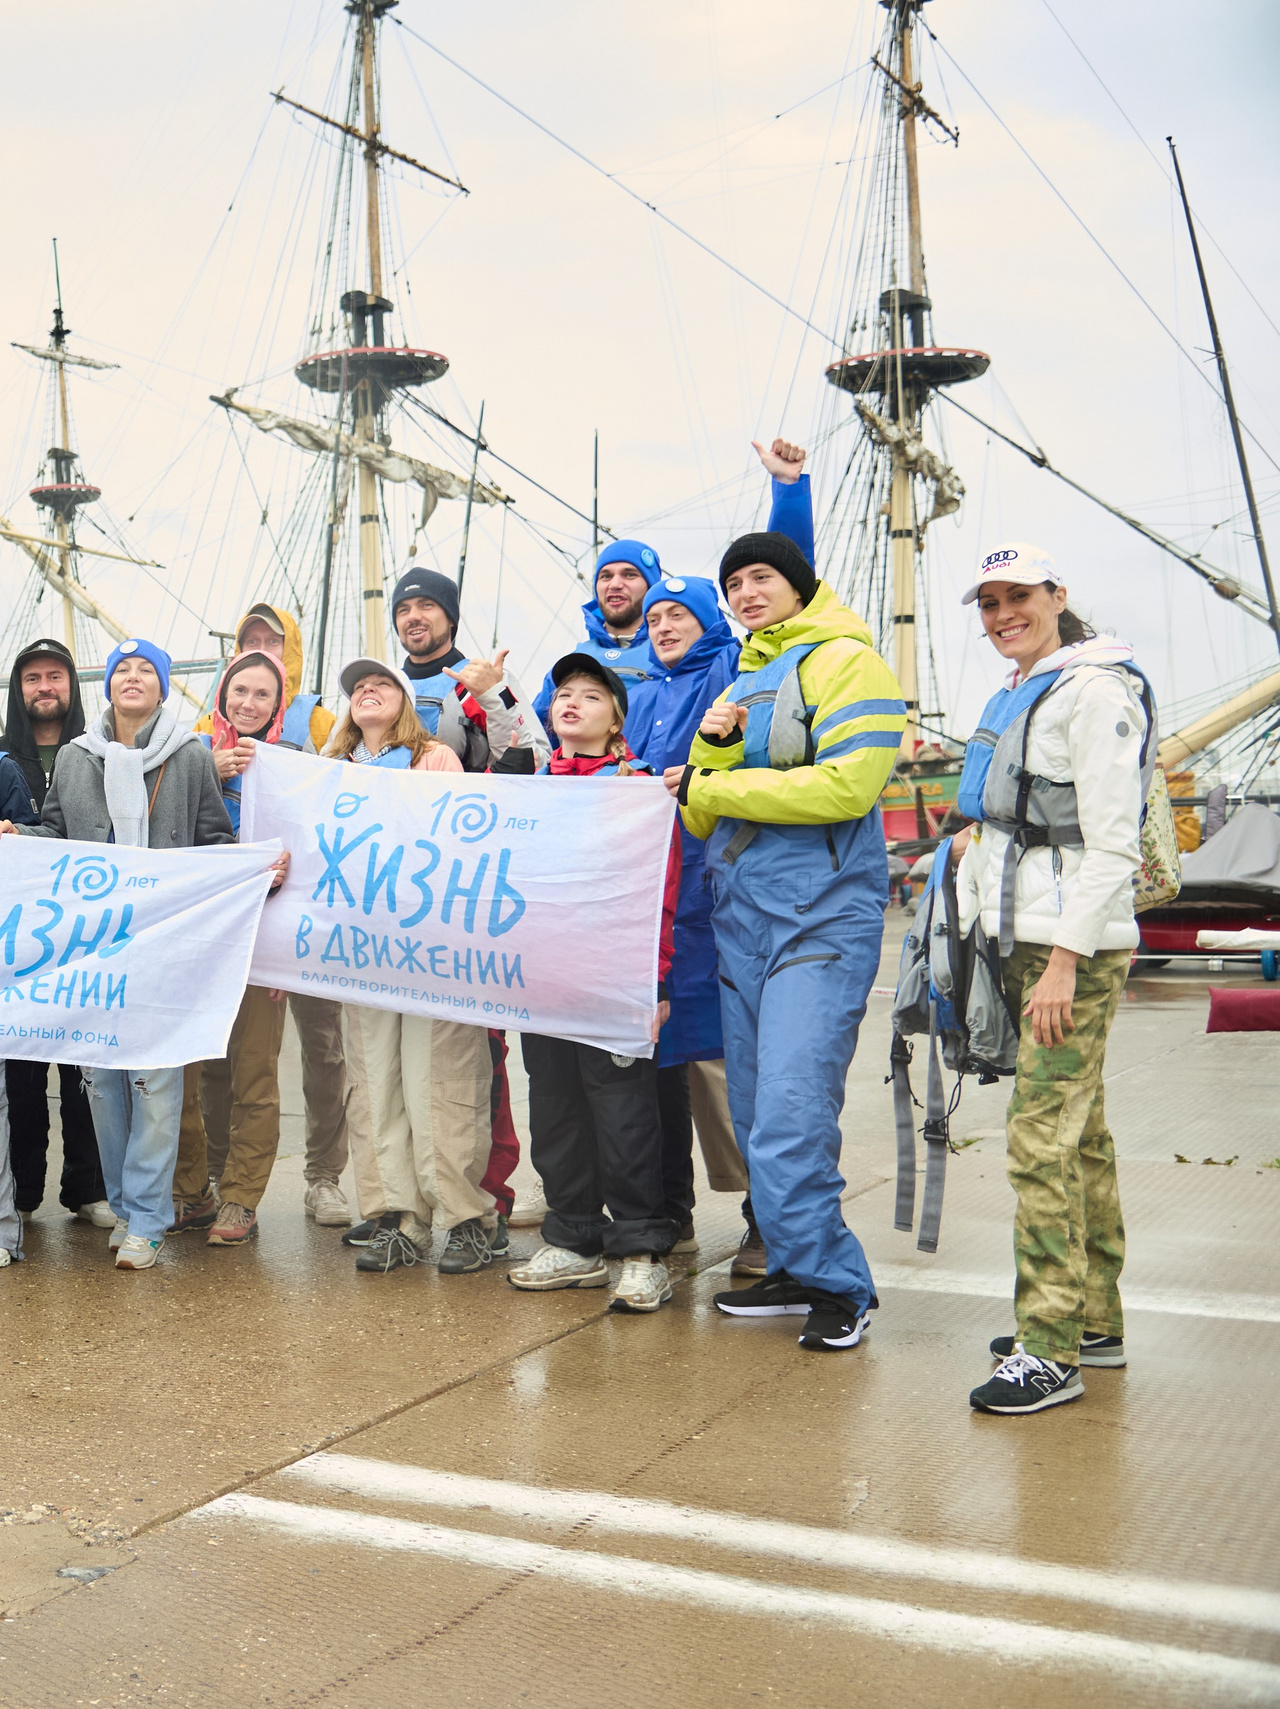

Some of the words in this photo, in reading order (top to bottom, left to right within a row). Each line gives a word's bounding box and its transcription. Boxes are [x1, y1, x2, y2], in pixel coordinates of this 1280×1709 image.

[504, 816, 540, 831] лет
[125, 875, 159, 889] лет
[312, 822, 526, 938] ЖИЗНЬ
[296, 914, 313, 959] В
[321, 923, 526, 989] ДВИЖЕНИИ
[301, 970, 476, 1010] БЛАГОТВОРИТЕЛЬНЫЙ
[482, 1001, 531, 1020] ФОНД
[71, 1029, 119, 1047] ФОНД
